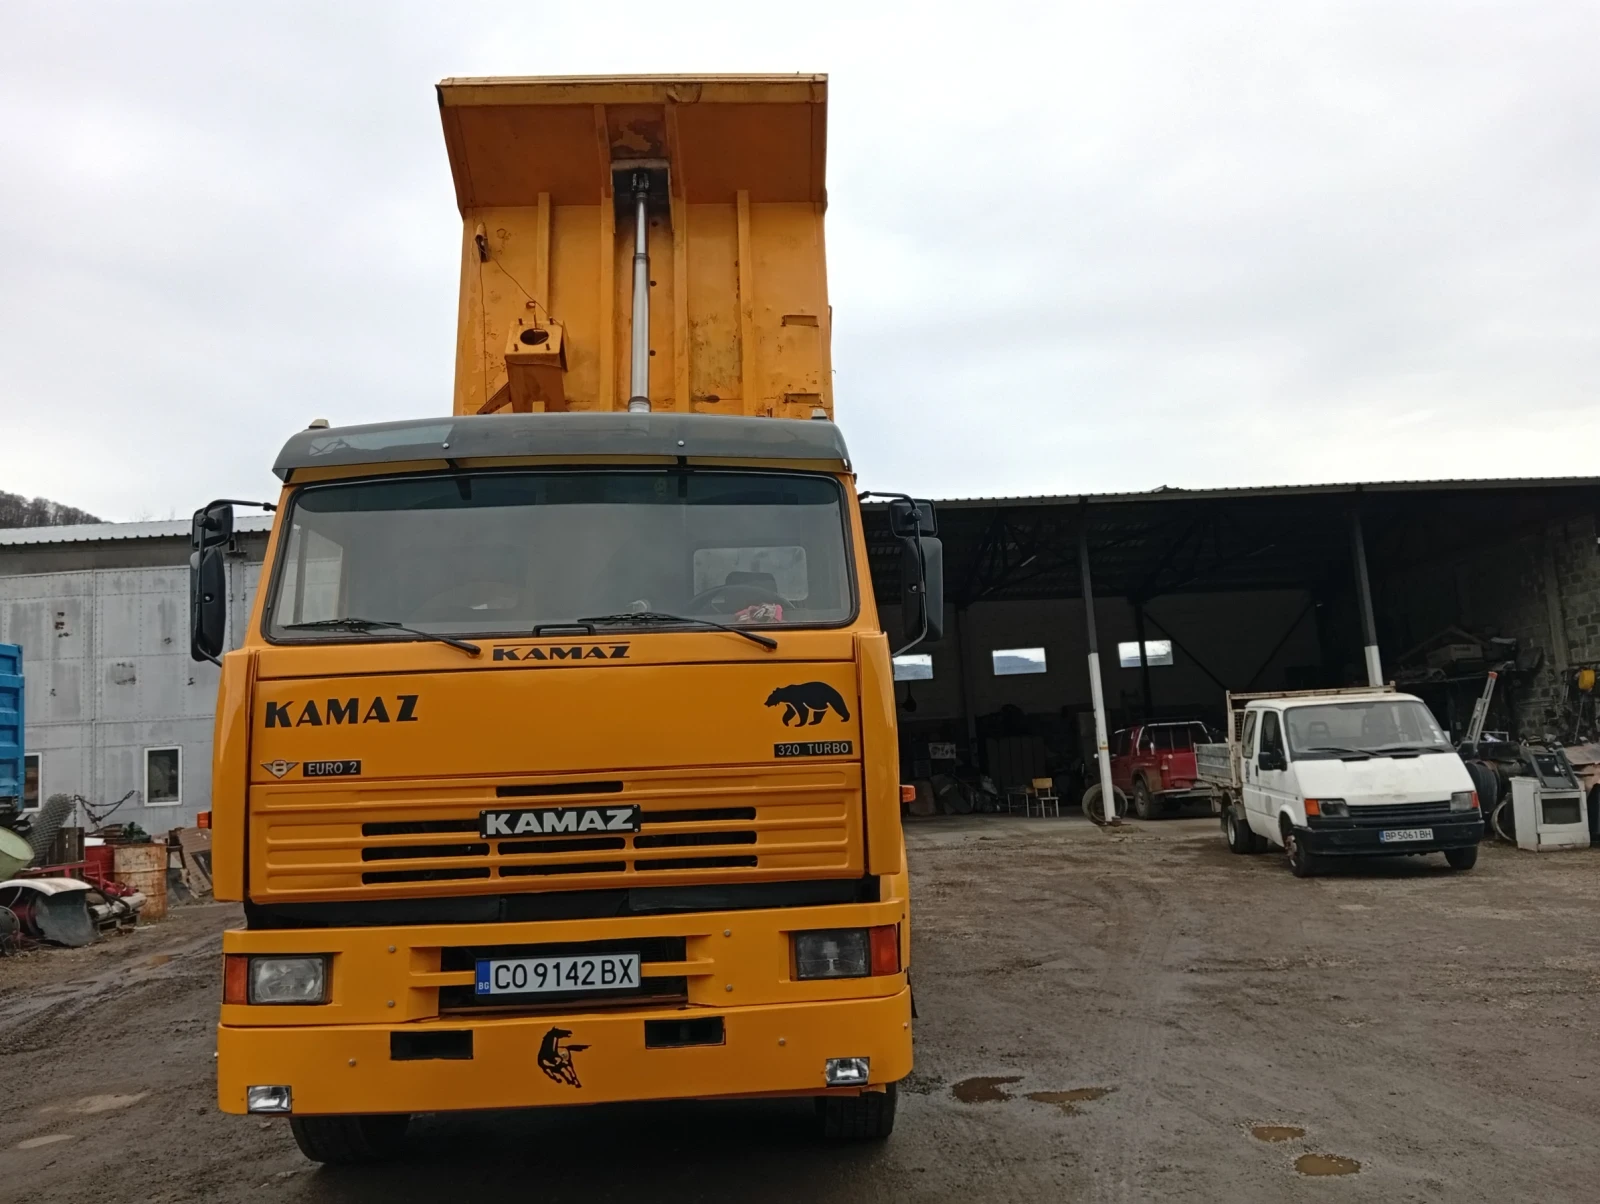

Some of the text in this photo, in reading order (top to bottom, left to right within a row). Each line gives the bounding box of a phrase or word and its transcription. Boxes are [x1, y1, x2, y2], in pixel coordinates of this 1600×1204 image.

[493, 645, 631, 661] KAMAZ
[265, 695, 419, 728] KAMAZ
[778, 742, 849, 756] 320 TURBO
[308, 762, 357, 775] EURO 2
[486, 809, 634, 835] KAMAZ
